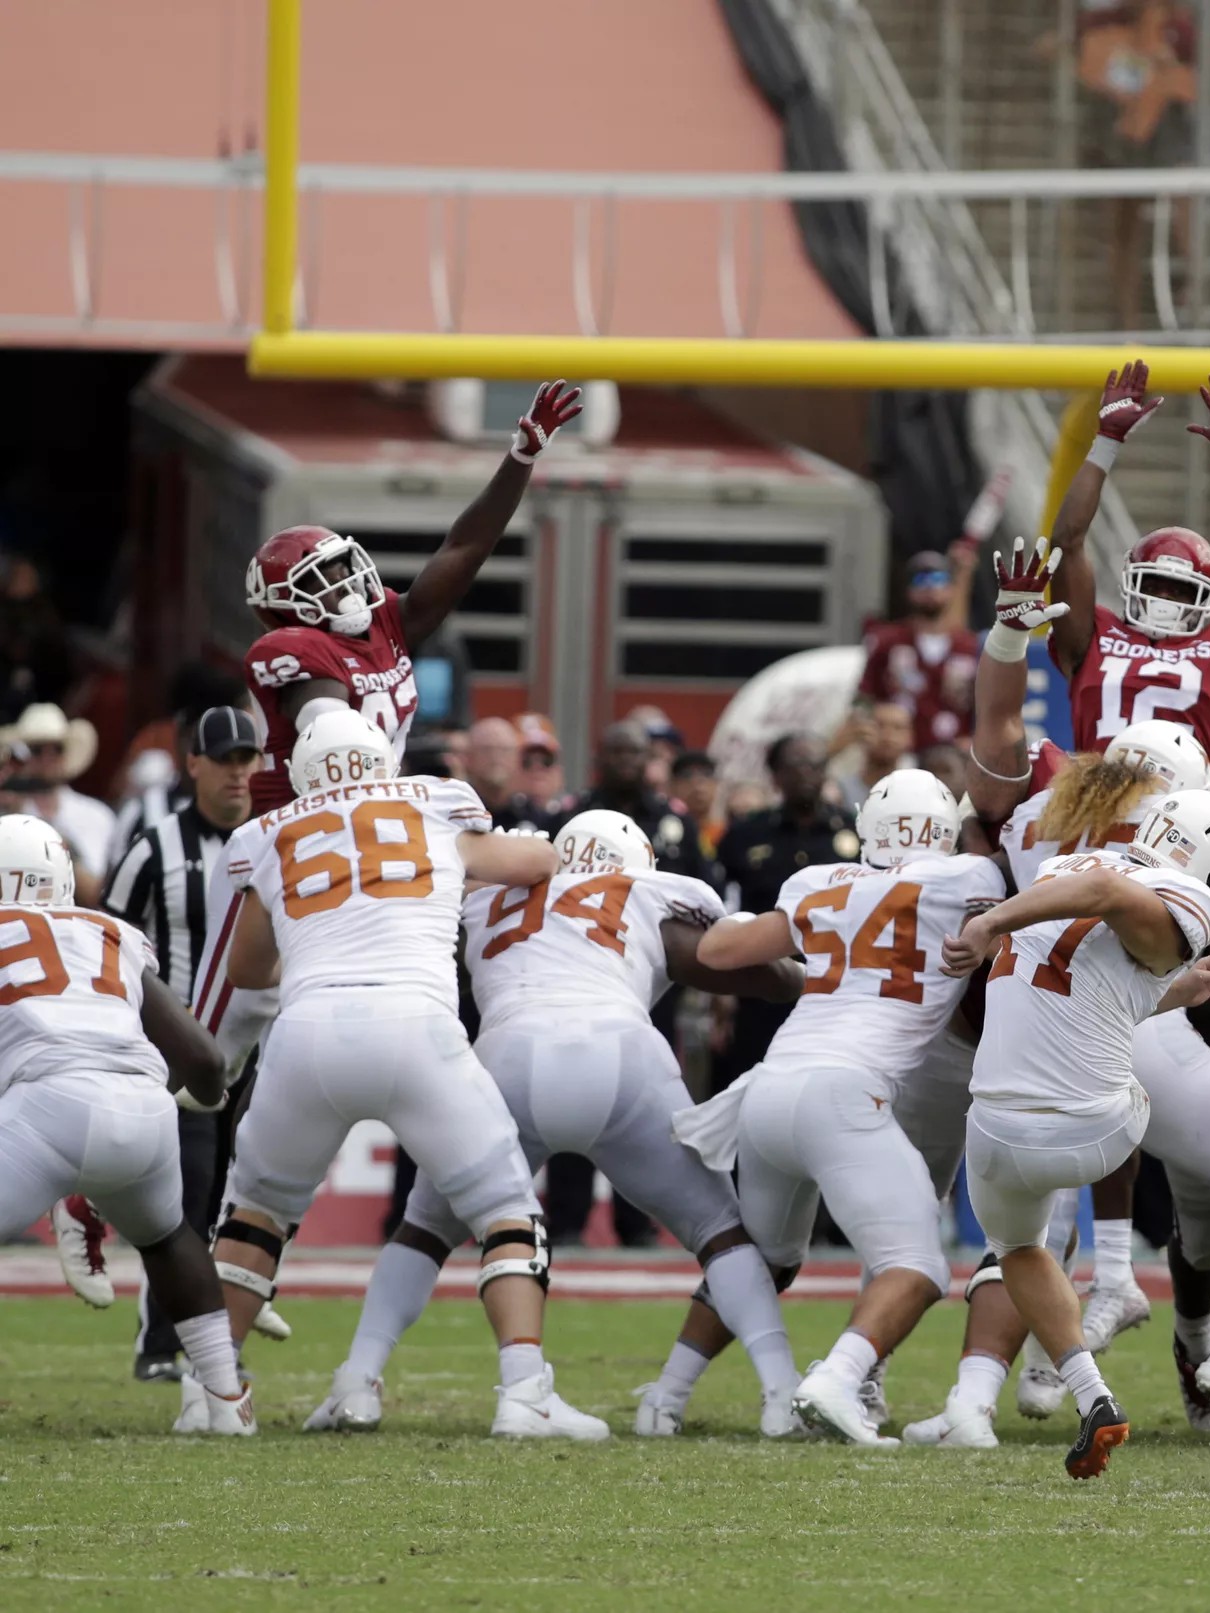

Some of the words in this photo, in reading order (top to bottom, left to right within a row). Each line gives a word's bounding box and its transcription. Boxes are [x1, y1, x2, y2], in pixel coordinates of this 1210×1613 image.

[1096, 655, 1203, 740] 12
[325, 750, 364, 784] 68
[258, 782, 431, 835] KERSTETTER
[1143, 812, 1175, 849] 17
[562, 835, 597, 866] 94
[898, 816, 934, 850] 54
[274, 800, 435, 920] 68
[0, 871, 24, 903] 7
[482, 876, 636, 960] 94
[793, 881, 927, 1005] 54
